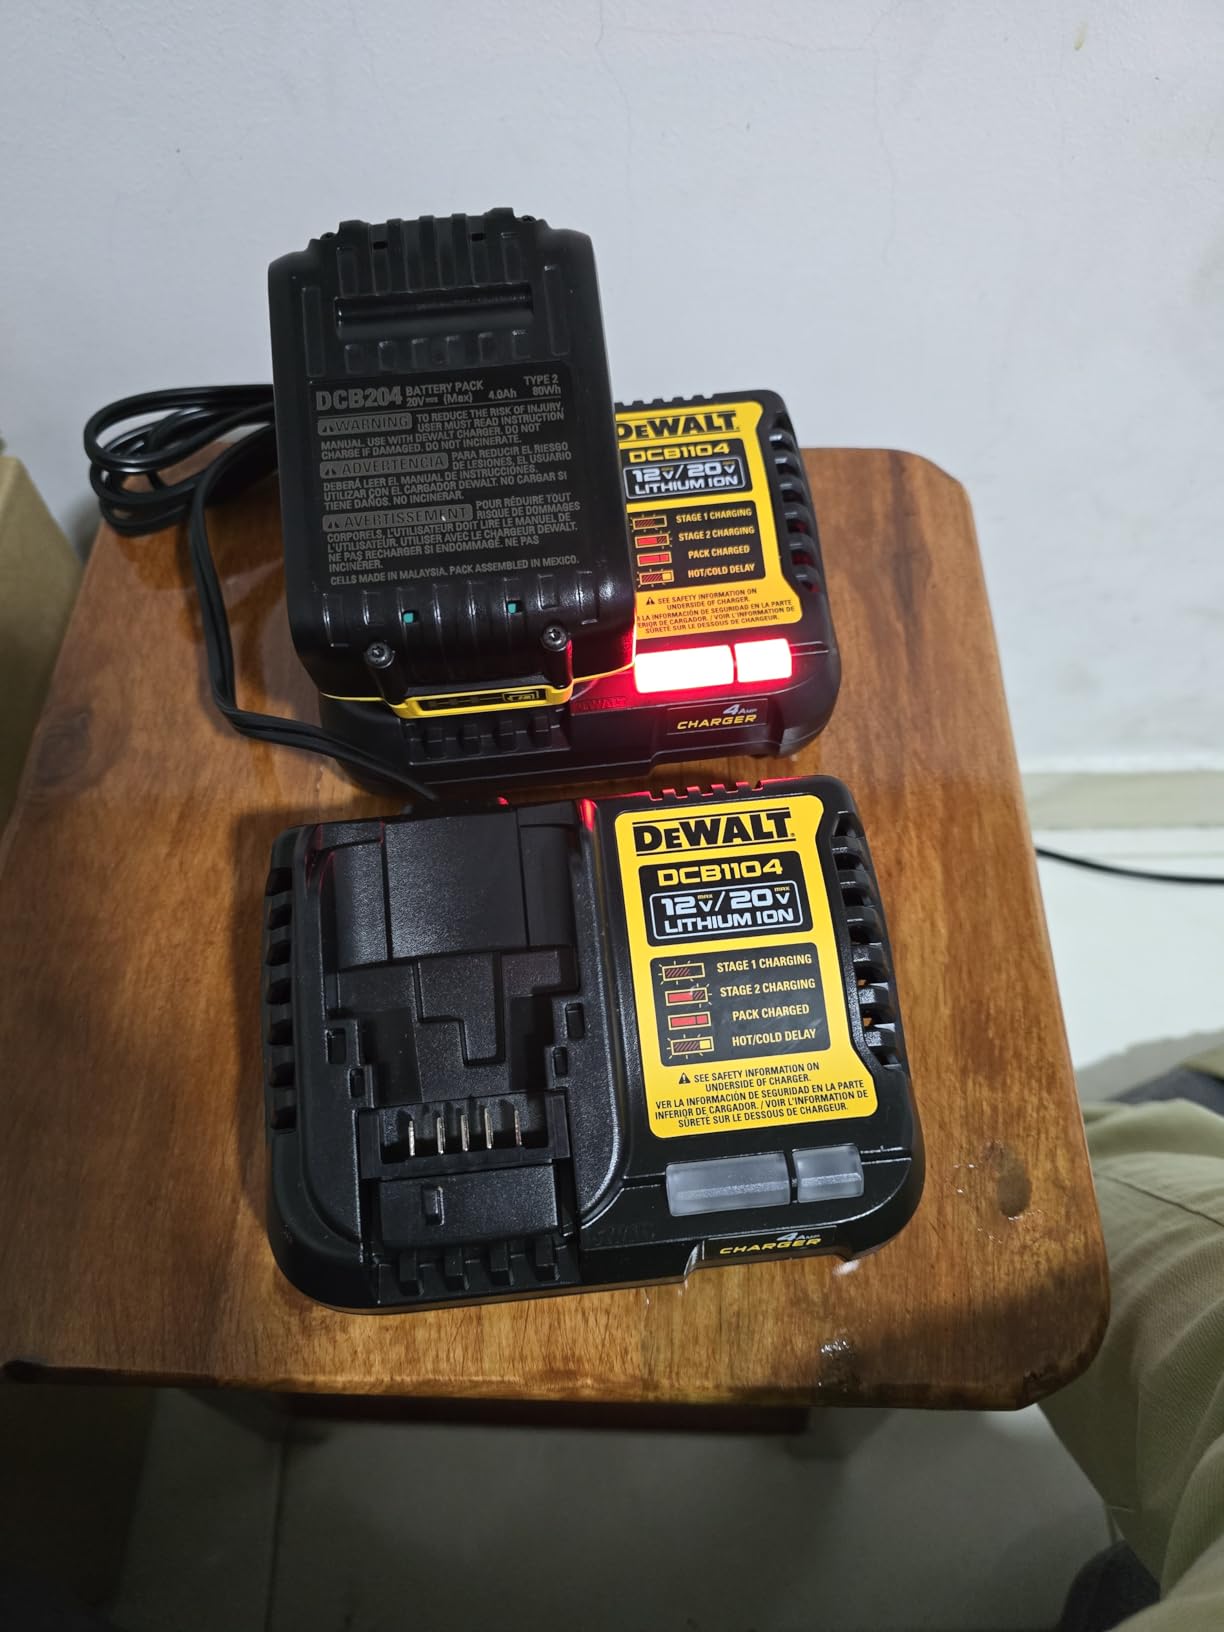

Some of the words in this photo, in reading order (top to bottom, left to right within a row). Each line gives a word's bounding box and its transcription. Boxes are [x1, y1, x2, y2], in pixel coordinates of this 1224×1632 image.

[405, 383, 452, 396] BATTERY
[454, 380, 483, 391] PACK
[523, 374, 550, 385] TYPE
[551, 374, 558, 383] 2
[315, 385, 403, 411] DCB204
[443, 392, 472, 404] (Max)
[488, 388, 516, 399] 4.0Ah
[532, 385, 561, 395] 80Wh
[416, 413, 429, 422] TO
[431, 410, 468, 420] REDUCE
[469, 408, 488, 417] THE
[489, 406, 511, 416] RISK
[513, 405, 525, 414] OF
[417, 421, 442, 432] USER
[444, 419, 472, 429] MUST
[473, 416, 498, 427] READ
[500, 411, 564, 424] INSTRUCTION
[336, 415, 409, 432] WARNING
[367, 436, 385, 446] USE
[387, 434, 413, 444] WITH
[415, 430, 454, 442] DEWALT
[504, 425, 518, 434] DO
[520, 423, 541, 433] NOT
[321, 448, 360, 459] CHARGE
[361, 447, 370, 456] IF
[425, 441, 439, 451] DO
[441, 439, 461, 449] NOT
[451, 450, 477, 460] PARA
[478, 446, 519, 458] REDUCIR
[521, 445, 532, 454] EL
[533, 442, 568, 453] RIESGO
[629, 443, 729, 463] DCB1104
[342, 455, 443, 474] ADVERTENCIA
[452, 460, 465, 470] DE
[516, 455, 527, 464] EL
[529, 451, 571, 463] USUARIO
[323, 489, 366, 501] UTILIZAR
[368, 487, 389, 497] CON
[390, 486, 402, 495] EL
[403, 481, 456, 494] CARGADOR
[500, 476, 514, 485] NO
[516, 472, 555, 484] CARGAR
[363, 476, 386, 488] LEER
[387, 475, 398, 485] EL
[400, 472, 443, 484] MANUAL
[444, 470, 457, 481] DE
[634, 478, 705, 494] LITHIUM
[707, 475, 738, 487] ION
[324, 500, 352, 511] TIENE
[392, 495, 407, 504] NO
[475, 498, 502, 509] POUR
[545, 492, 571, 502] TOUT
[342, 507, 467, 528] AVERTISSEMENT
[476, 508, 509, 519] RISQUE
[511, 506, 523, 516] DE
[525, 501, 580, 514] DOMMAGES
[675, 513, 701, 523] STAGE
[703, 512, 707, 520] 1
[709, 508, 752, 519] CHARGING
[455, 520, 478, 531] DOIT
[480, 518, 500, 529] LIRE
[502, 517, 513, 527] LE
[514, 514, 556, 526] MANUEL
[557, 512, 570, 522] DE
[678, 531, 704, 541] STAGE
[705, 530, 710, 538] 2
[711, 526, 754, 537] CHARGING
[688, 549, 709, 558] PACK
[711, 545, 749, 556] CHARGED
[330, 574, 357, 585] CELLS
[358, 572, 385, 582] MADE
[387, 571, 397, 580] IN
[449, 564, 473, 574] PACK
[474, 559, 528, 572] ASSEMBLED
[530, 558, 540, 567] IN
[687, 566, 728, 577] HOT/COLD
[729, 563, 754, 573] DELAY
[671, 594, 696, 602] SAFETY
[698, 589, 745, 599] INFORMATION
[677, 714, 757, 730] CHARGER
[657, 857, 783, 885] DCB1104
[664, 911, 752, 933] LITHIUM
[755, 907, 793, 924] ION
[716, 960, 749, 972] STAGE
[751, 959, 756, 969] 1
[758, 953, 812, 968] CHARGING
[719, 984, 752, 997] STAGE
[754, 983, 760, 993] 2
[762, 978, 815, 993] CHARGING
[732, 1009, 759, 1020] PACK
[761, 1004, 809, 1017] CHARGED
[731, 1031, 782, 1046] HOT/COLD
[784, 1028, 816, 1041] DELAY
[693, 1073, 709, 1082] SEE
[711, 1069, 743, 1080] SAFETY
[744, 1063, 804, 1077] INFORMATION
[806, 1061, 819, 1070] ON
[705, 1079, 753, 1092] UNDERSIDE
[756, 1077, 766, 1086] OF
[655, 1099, 671, 1109] VER
[673, 1098, 684, 1107] LA
[748, 1090, 759, 1099] DE
[761, 1085, 809, 1098] SEGURIDAD
[811, 1083, 823, 1092] EN
[824, 1082, 836, 1091] LA
[837, 1079, 863, 1090] PARTE
[654, 1108, 693, 1120] INFERIOR
[695, 1107, 706, 1116] DE
[765, 1098, 785, 1108] VOIR
[787, 1090, 854, 1105] L'INFORMATION
[856, 1089, 867, 1098] DE
[712, 1114, 730, 1124] SUR
[732, 1112, 741, 1122] LE
[743, 1108, 784, 1121] DESSOUS
[786, 1106, 797, 1116] DE
[720, 1238, 822, 1255] CHARGER
